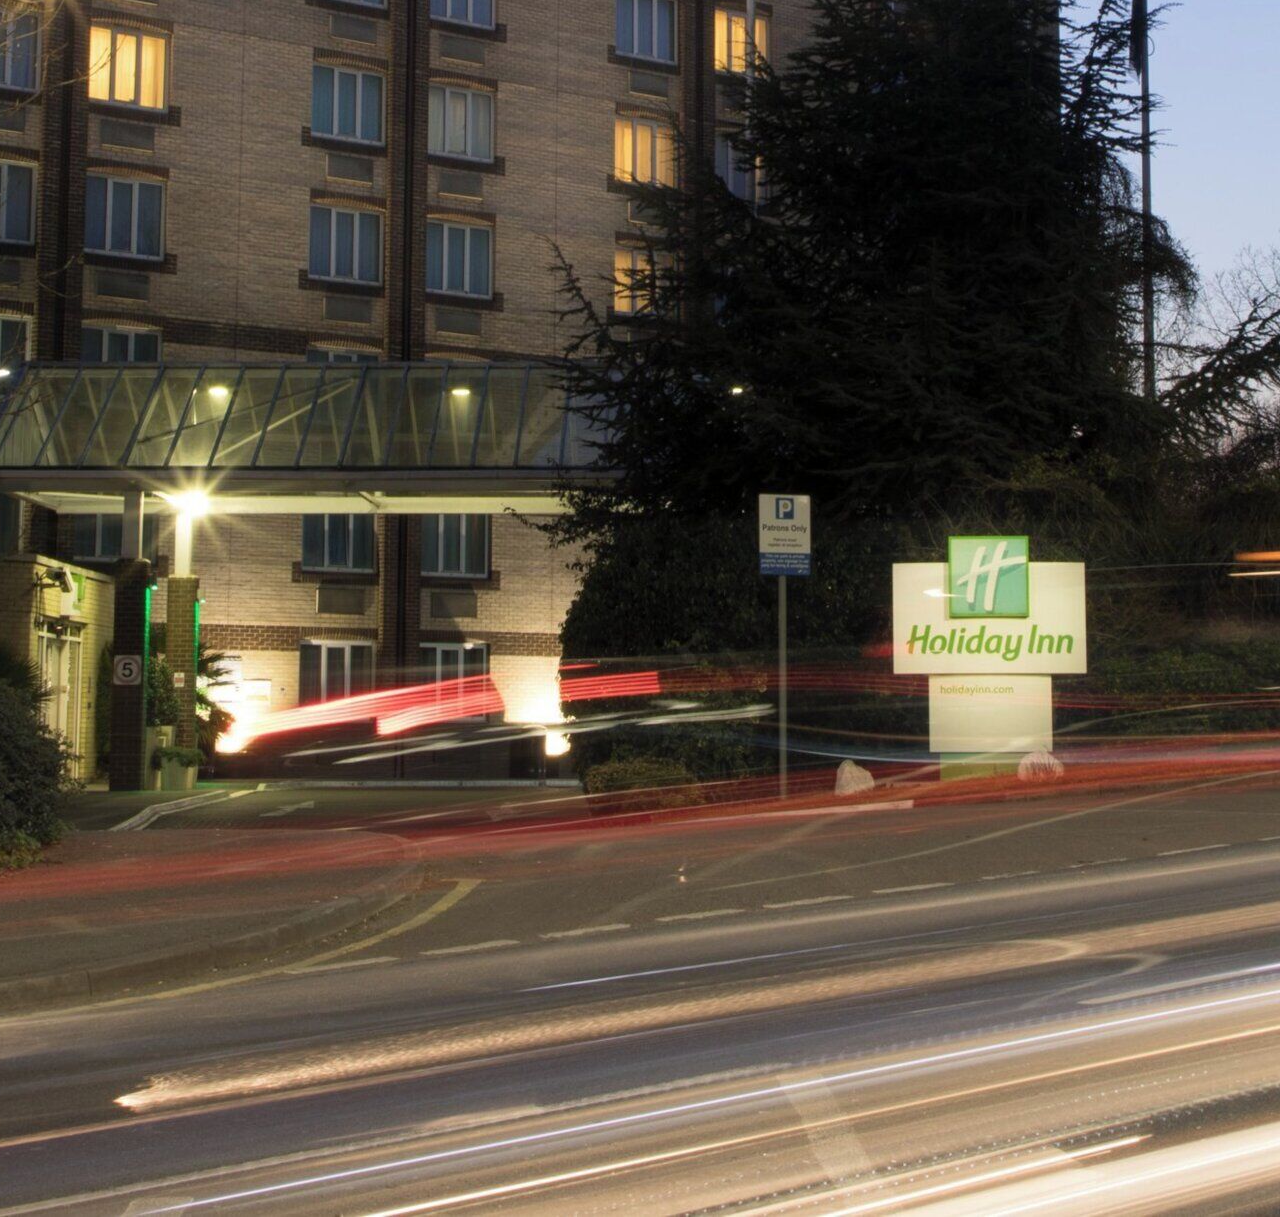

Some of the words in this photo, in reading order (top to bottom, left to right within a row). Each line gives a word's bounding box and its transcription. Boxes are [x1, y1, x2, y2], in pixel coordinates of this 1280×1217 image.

[762, 523, 789, 533] Patrons
[791, 524, 807, 534] Only
[906, 624, 1023, 662] Holiday
[1027, 624, 1074, 655] Inn
[121, 661, 133, 678] 5
[939, 685, 1015, 697] holidayinn.com
